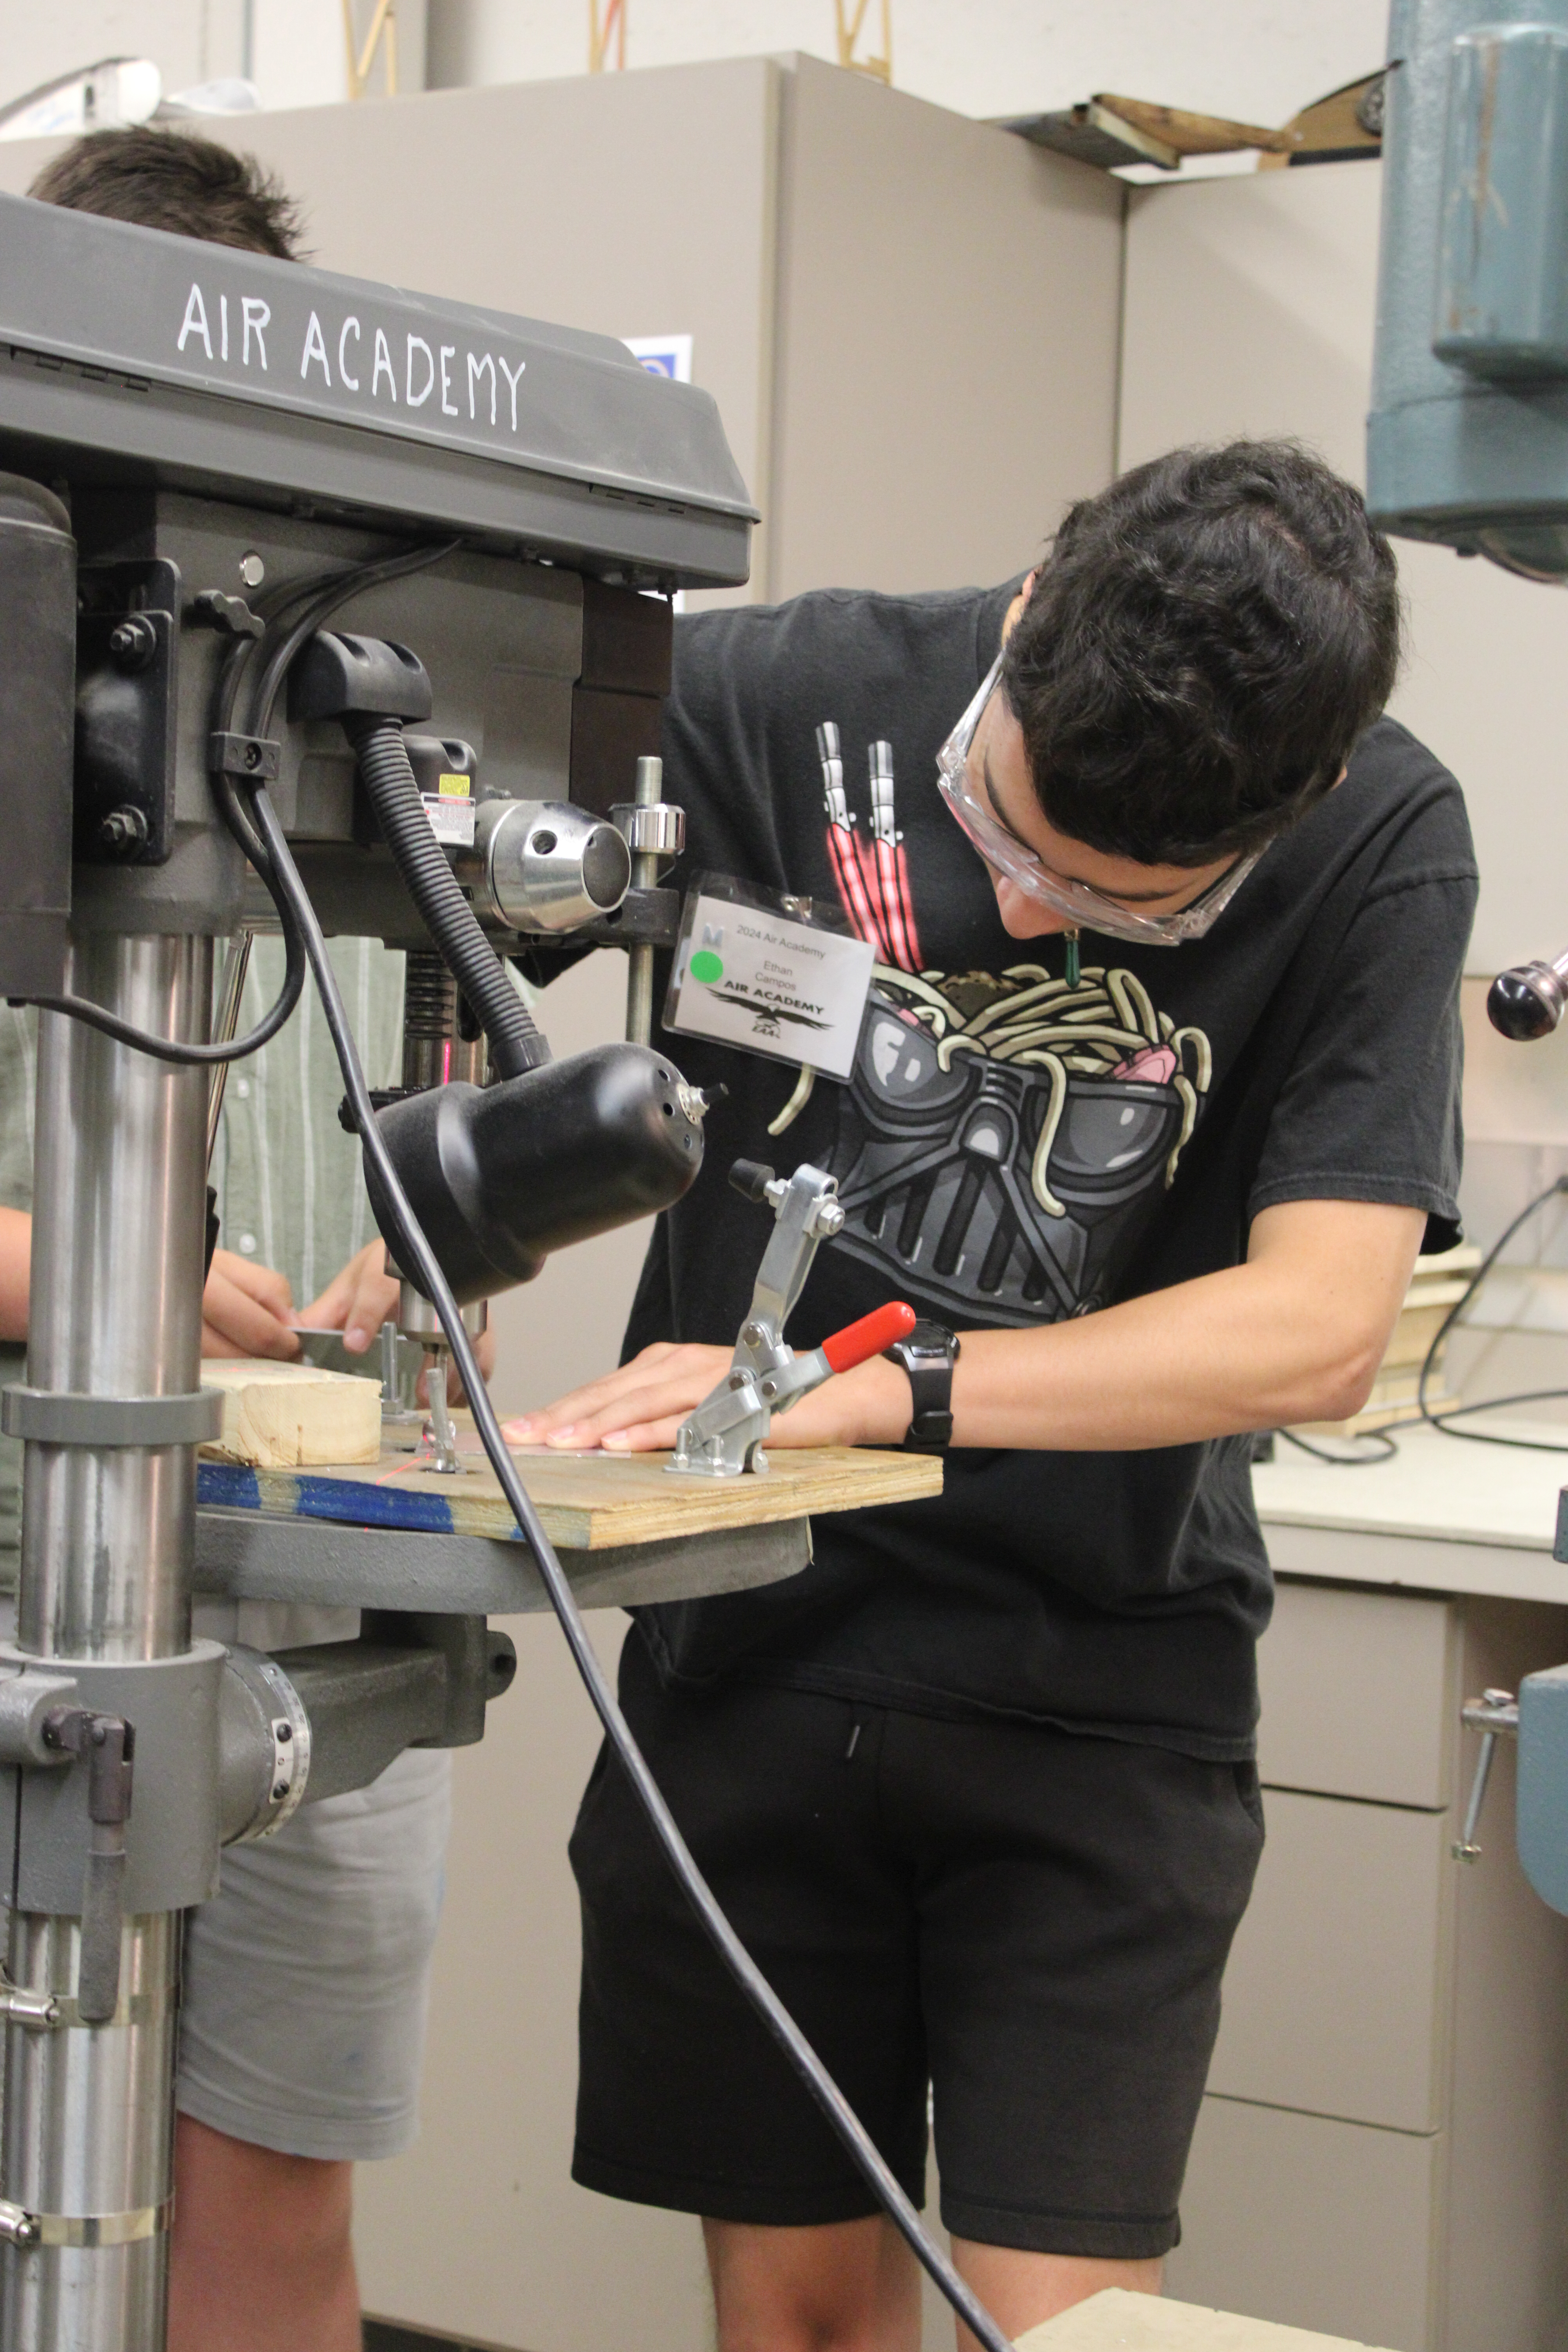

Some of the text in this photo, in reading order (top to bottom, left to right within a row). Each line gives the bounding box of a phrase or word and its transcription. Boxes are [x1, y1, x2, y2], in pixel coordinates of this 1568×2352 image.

[177, 283, 525, 432] AIR ACADEMY
[737, 925, 826, 959] 2024 Air Academy
[755, 972, 797, 991] Campos
[764, 961, 793, 975] Ethan
[724, 981, 824, 1014] AIR ACADEMY
